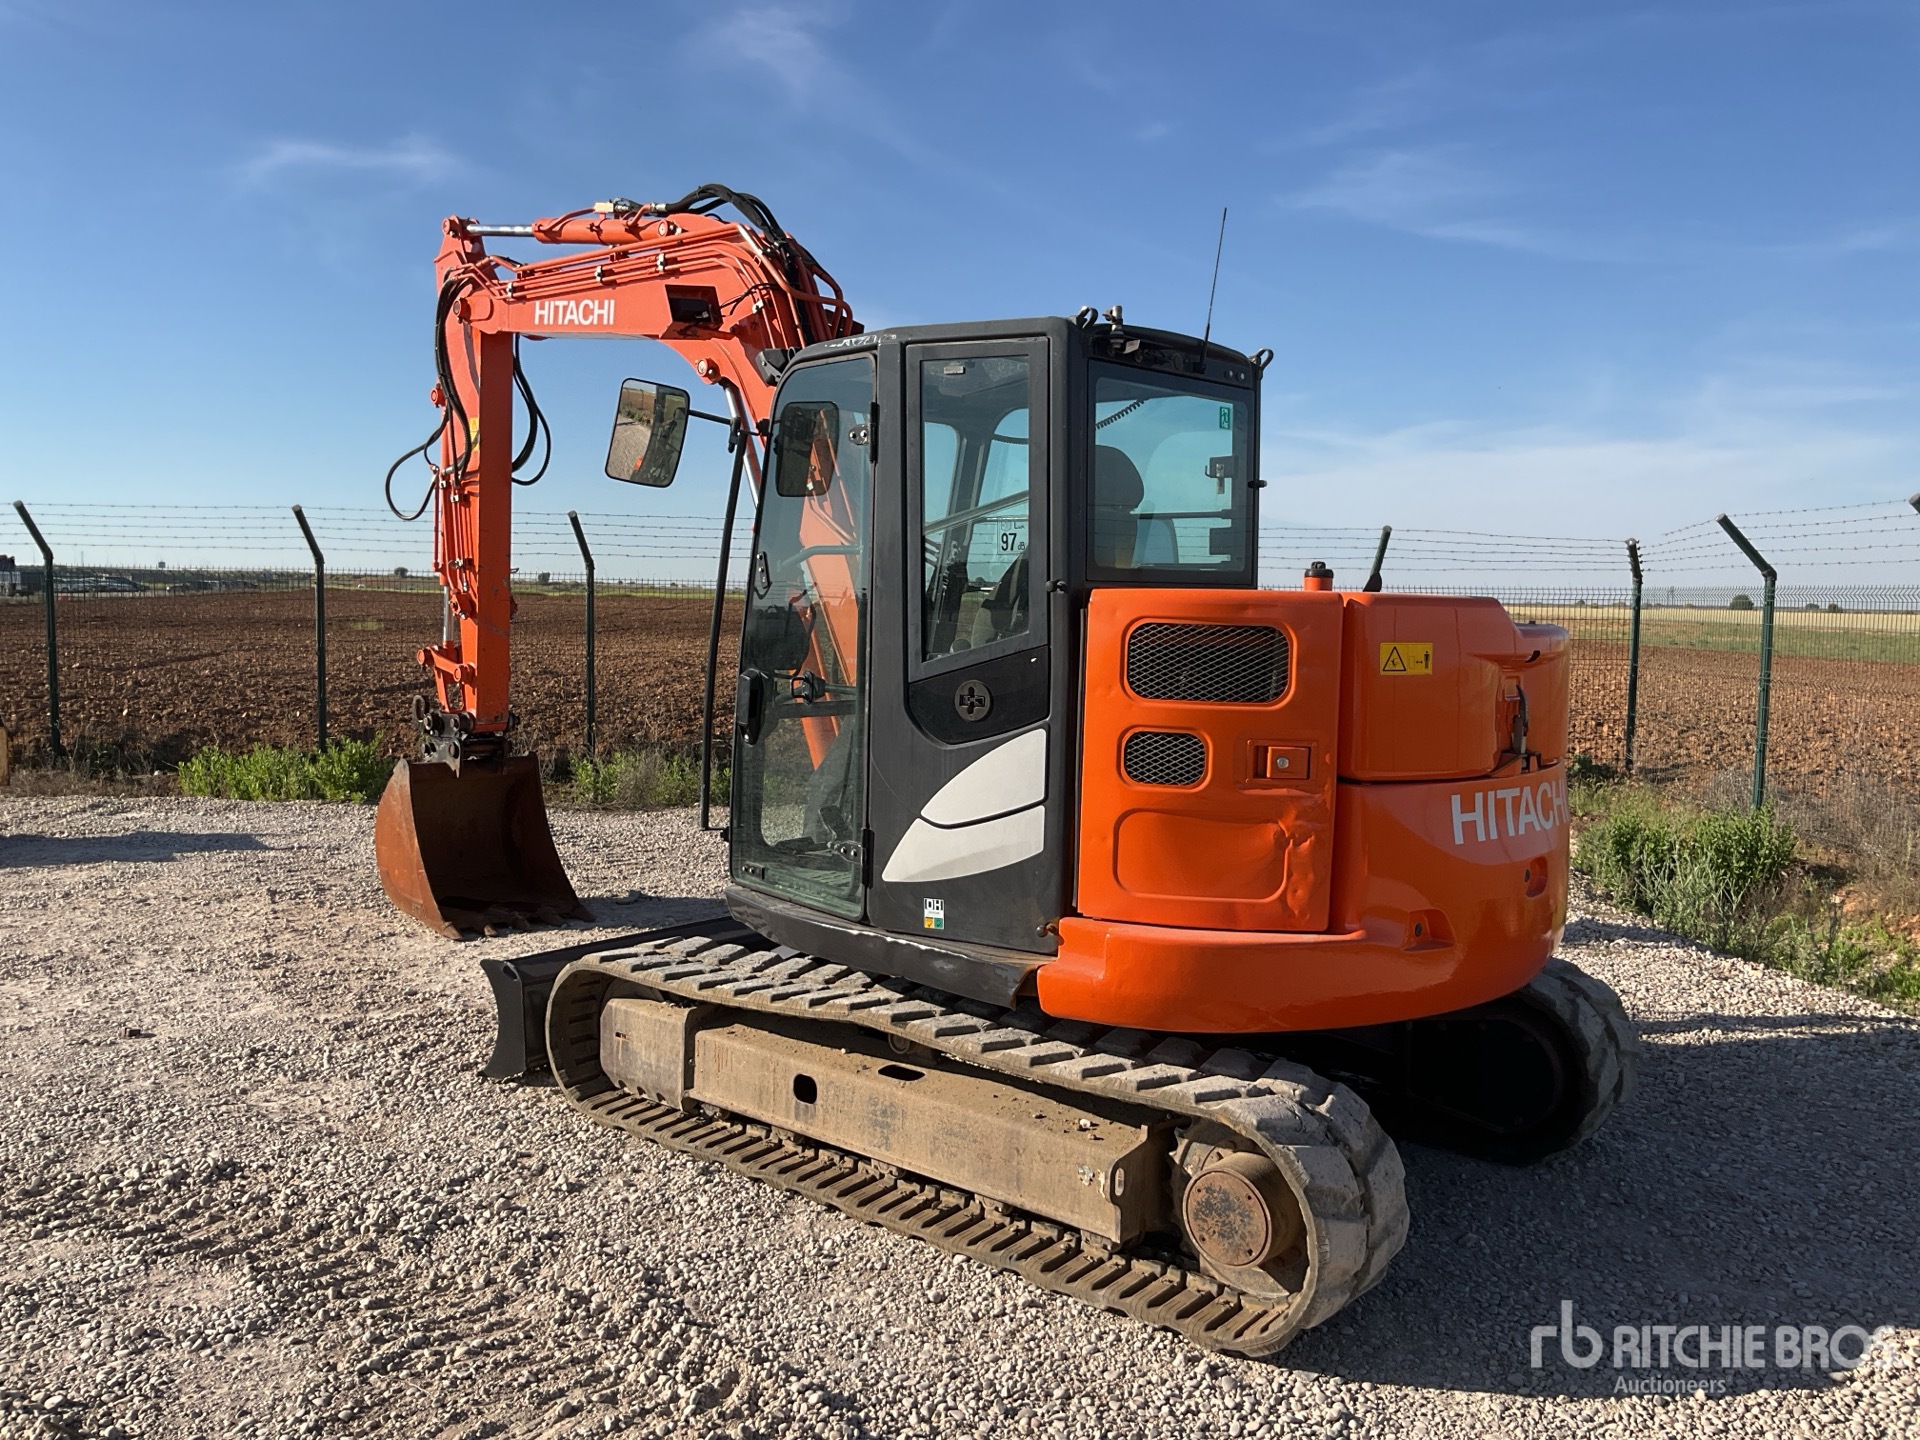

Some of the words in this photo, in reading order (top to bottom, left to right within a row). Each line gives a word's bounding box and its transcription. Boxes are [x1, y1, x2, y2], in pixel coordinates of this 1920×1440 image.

[534, 299, 615, 326] HITACHI
[1001, 532, 1017, 552] 97
[1451, 779, 1570, 845] HITACHI
